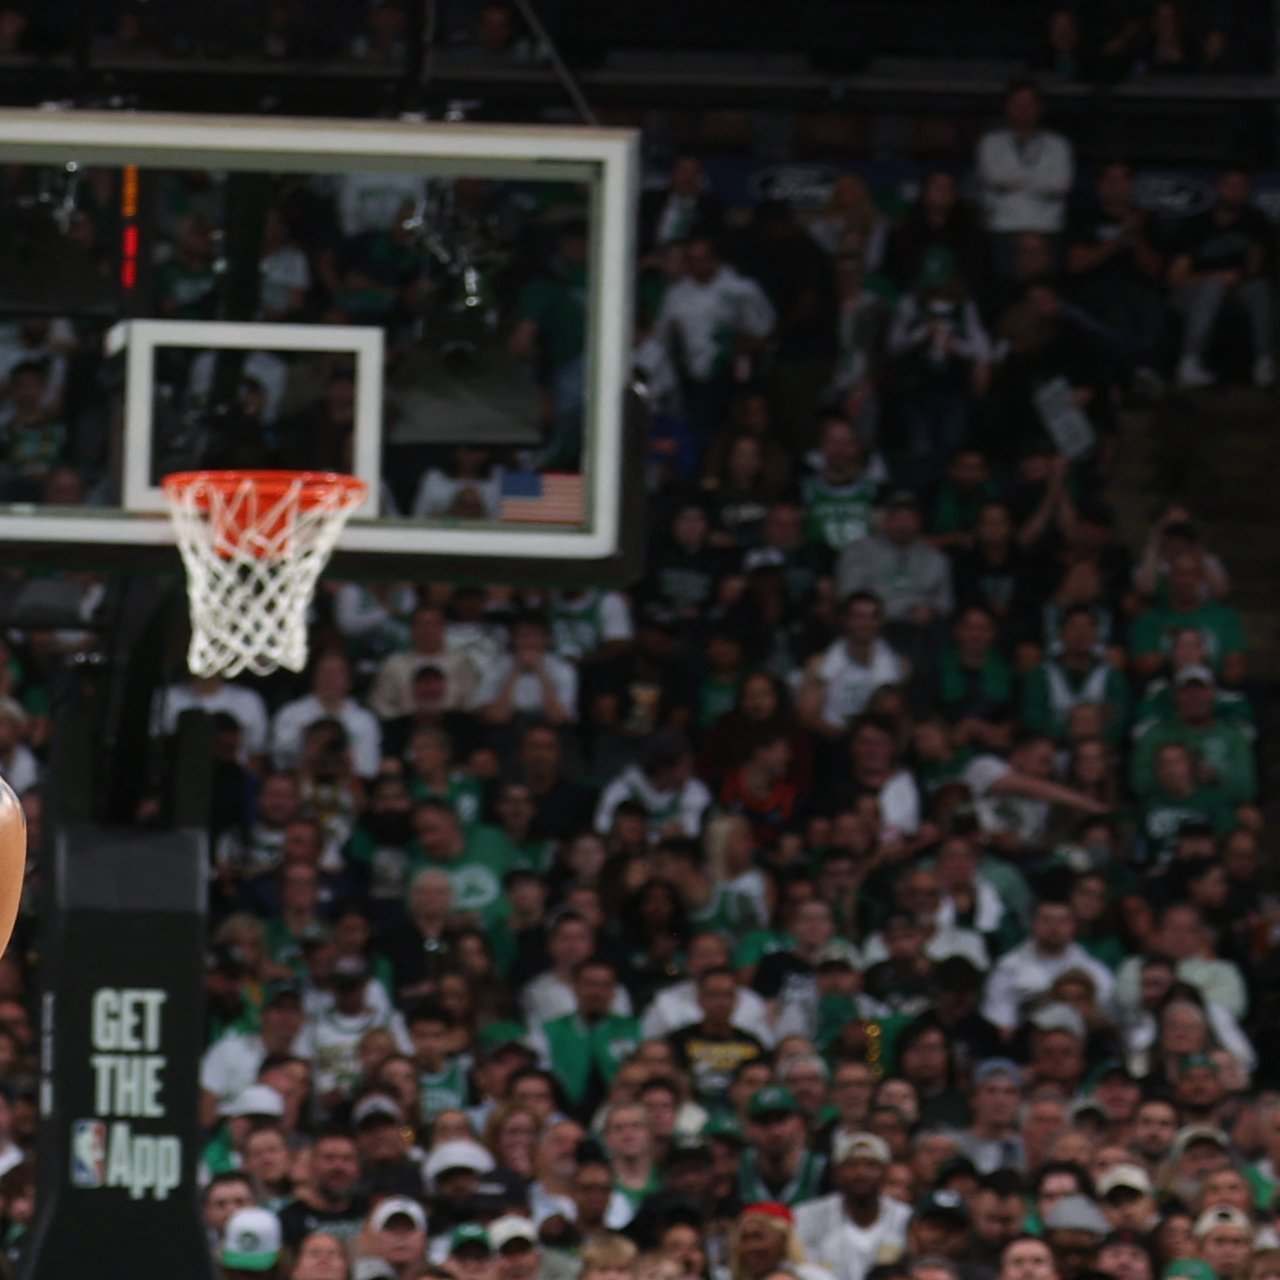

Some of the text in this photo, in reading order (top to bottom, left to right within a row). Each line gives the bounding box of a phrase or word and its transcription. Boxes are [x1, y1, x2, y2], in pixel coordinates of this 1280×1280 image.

[92, 987, 167, 1051] GET
[91, 1056, 166, 1118] THE
[106, 1121, 181, 1200] App
